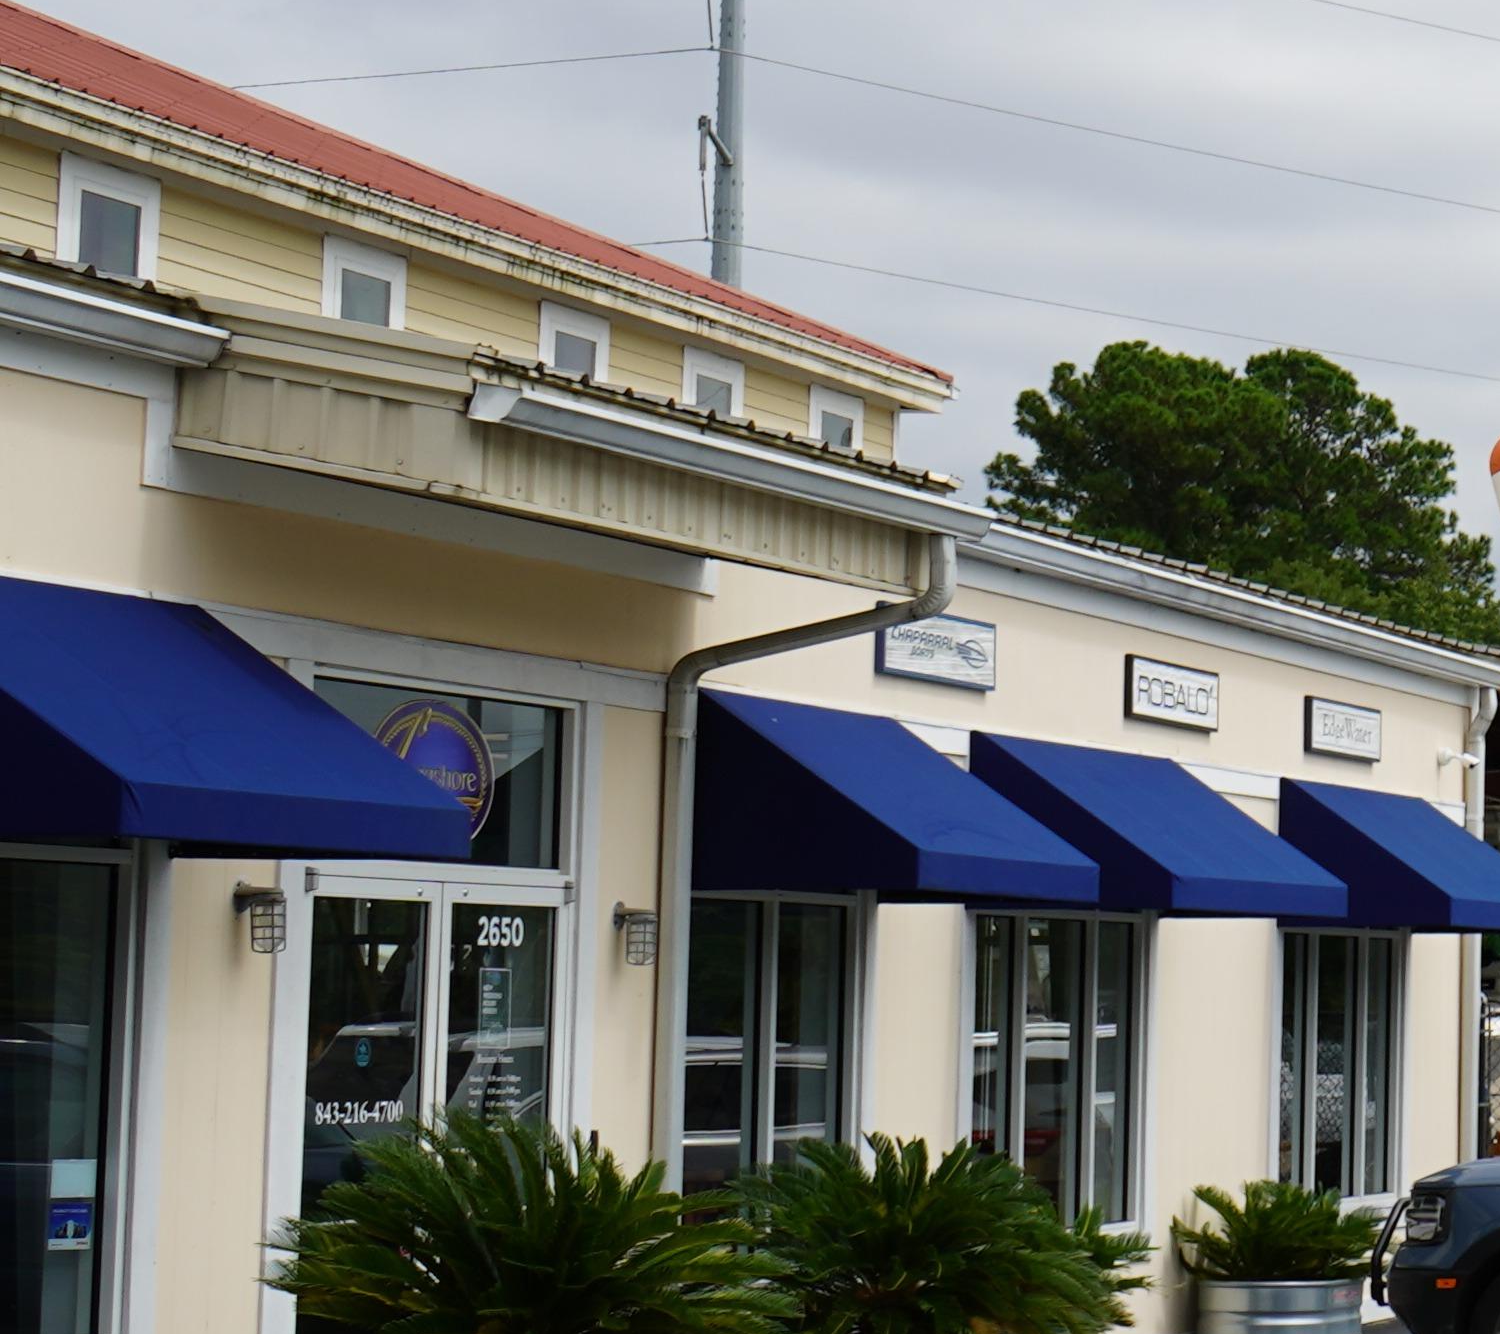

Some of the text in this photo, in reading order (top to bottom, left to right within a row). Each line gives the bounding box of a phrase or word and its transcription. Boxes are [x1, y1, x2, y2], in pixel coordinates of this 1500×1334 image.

[890, 626, 954, 651] CHAPARRAL
[1137, 675, 1209, 715] ROBALO
[1322, 713, 1372, 744] EdgeWater
[477, 916, 525, 947] 2650
[315, 1100, 404, 1125] 843-216-4700
